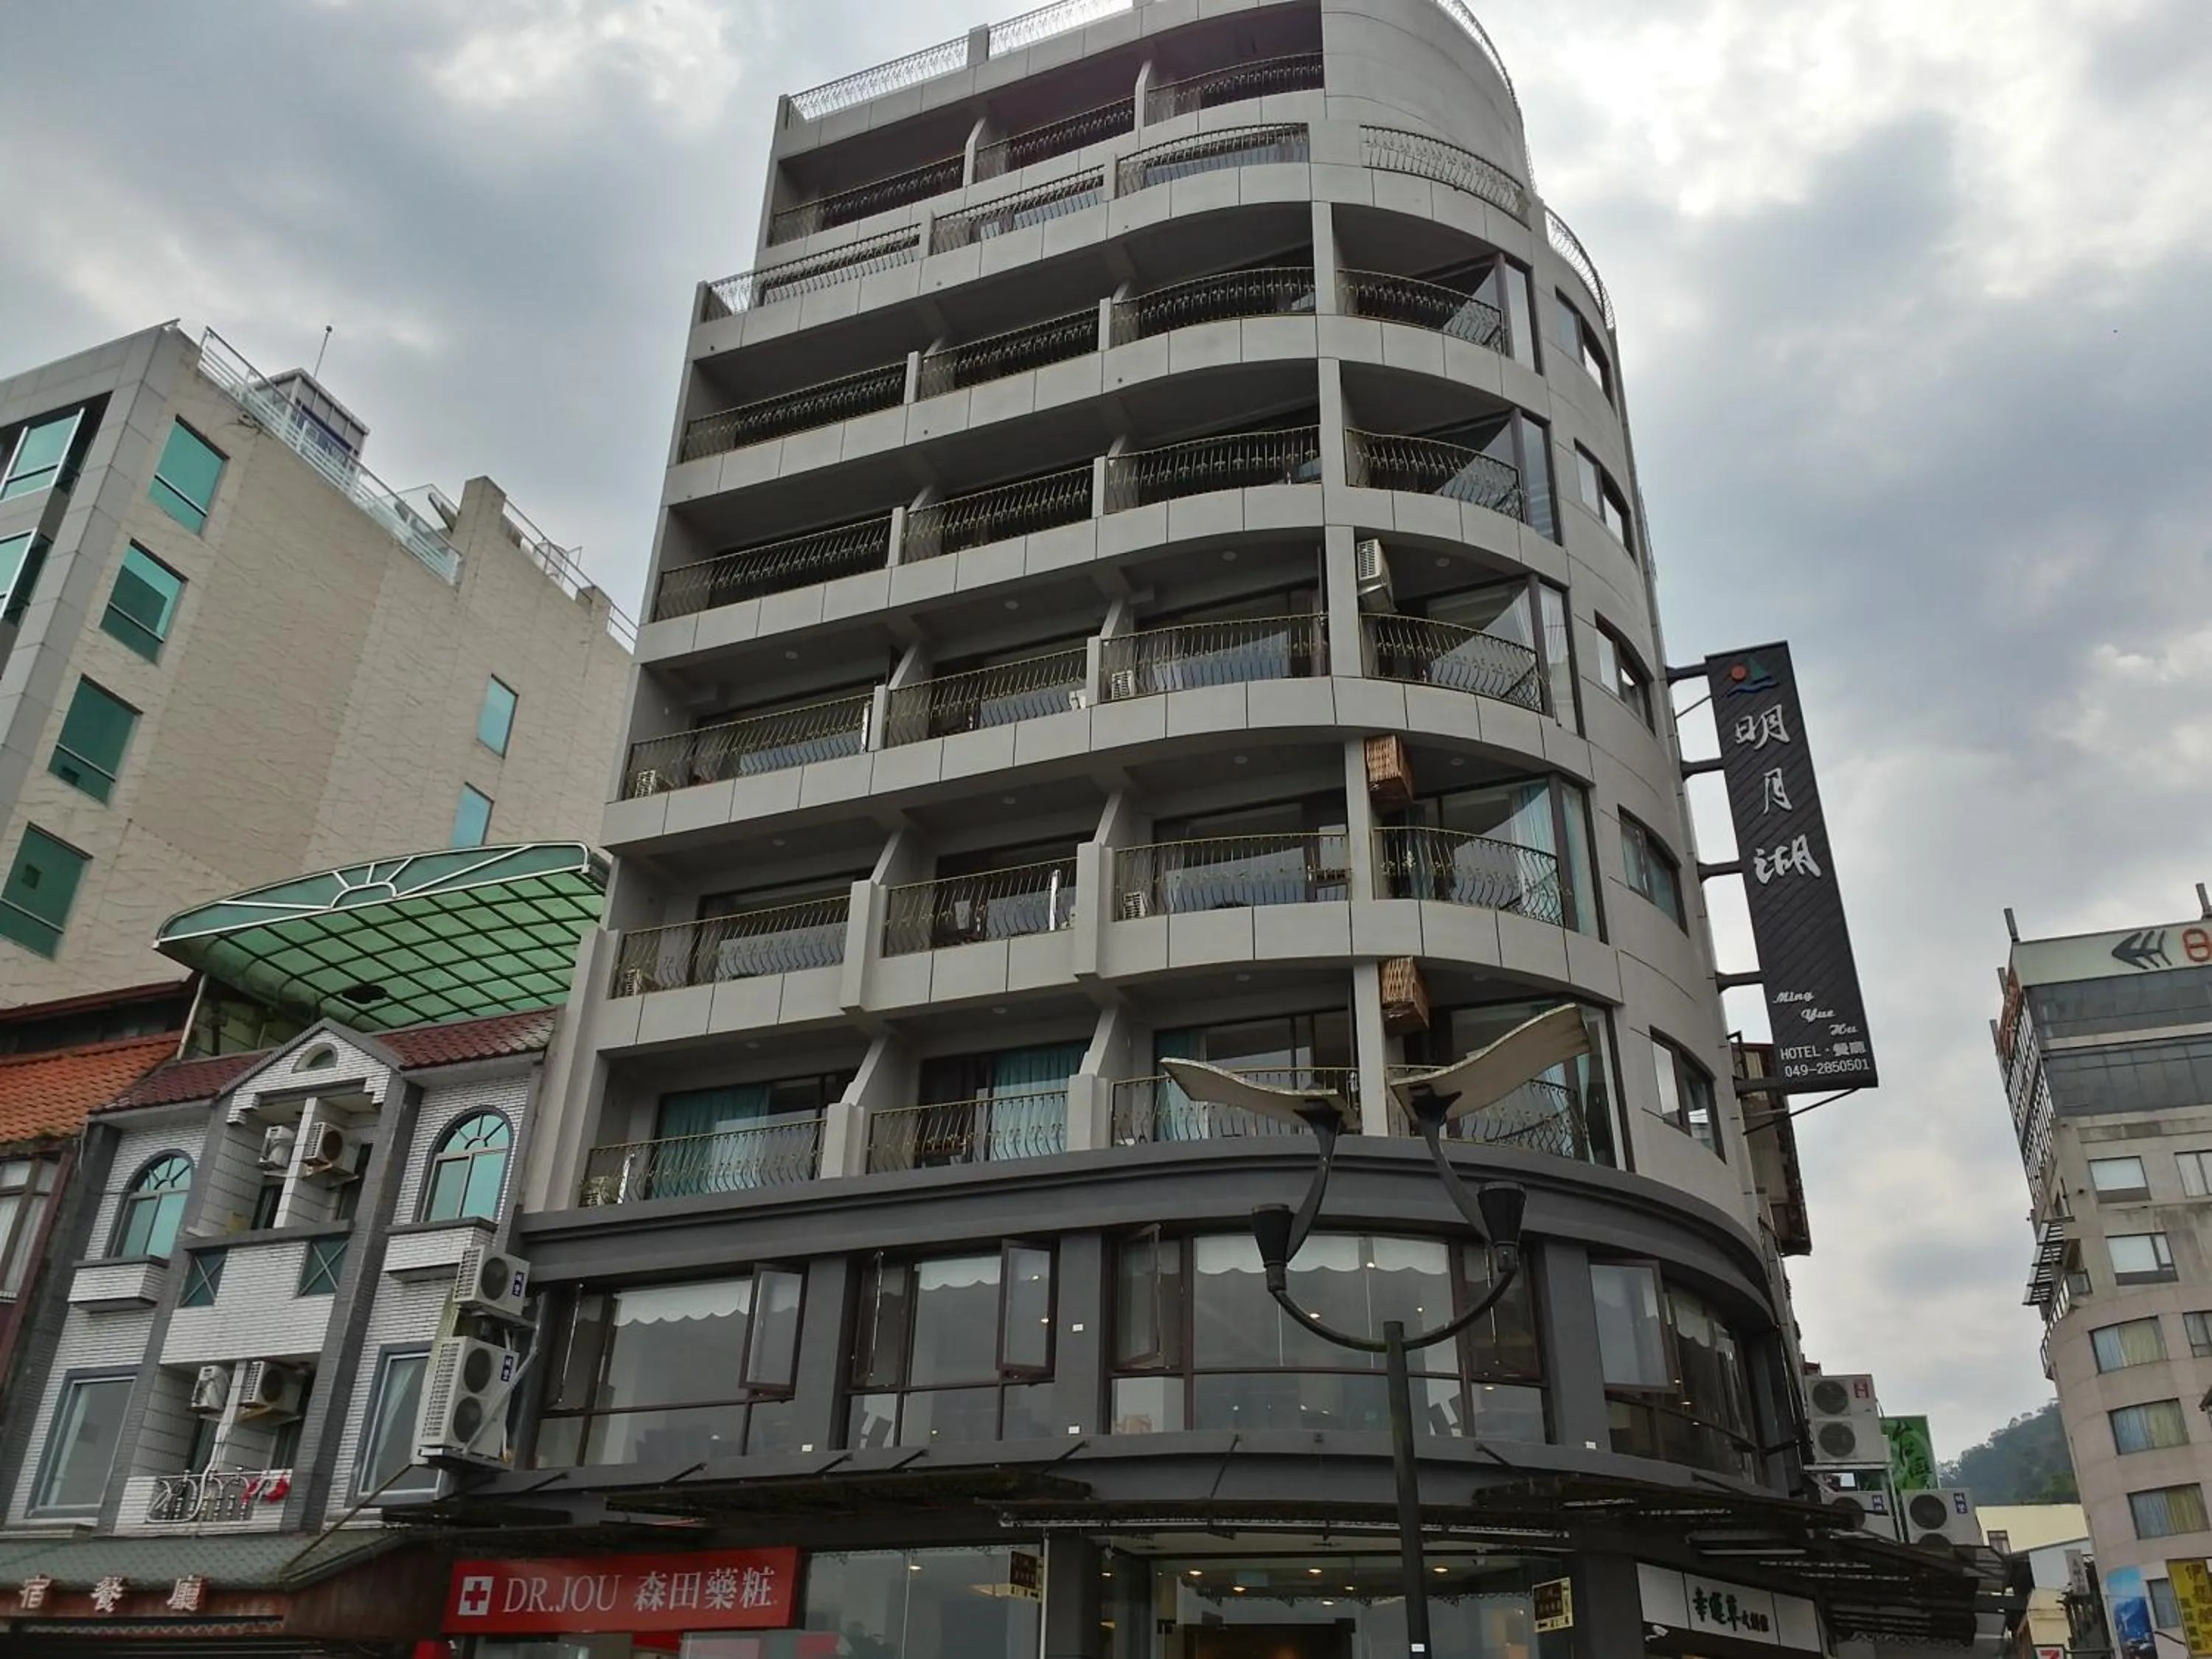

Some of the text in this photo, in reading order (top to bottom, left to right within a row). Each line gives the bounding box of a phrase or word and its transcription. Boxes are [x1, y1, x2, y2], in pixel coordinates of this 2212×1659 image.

[1735, 703, 1822, 884] 明月湖
[1773, 990, 1815, 1004] Ming
[1801, 1007, 1836, 1023] Yue
[1829, 1023, 1859, 1036] Hu
[1780, 1045, 1821, 1060] HOTEL
[1784, 1058, 1869, 1077] 049-2850501
[502, 1566, 775, 1613] DR.JOU 森田藥粧
